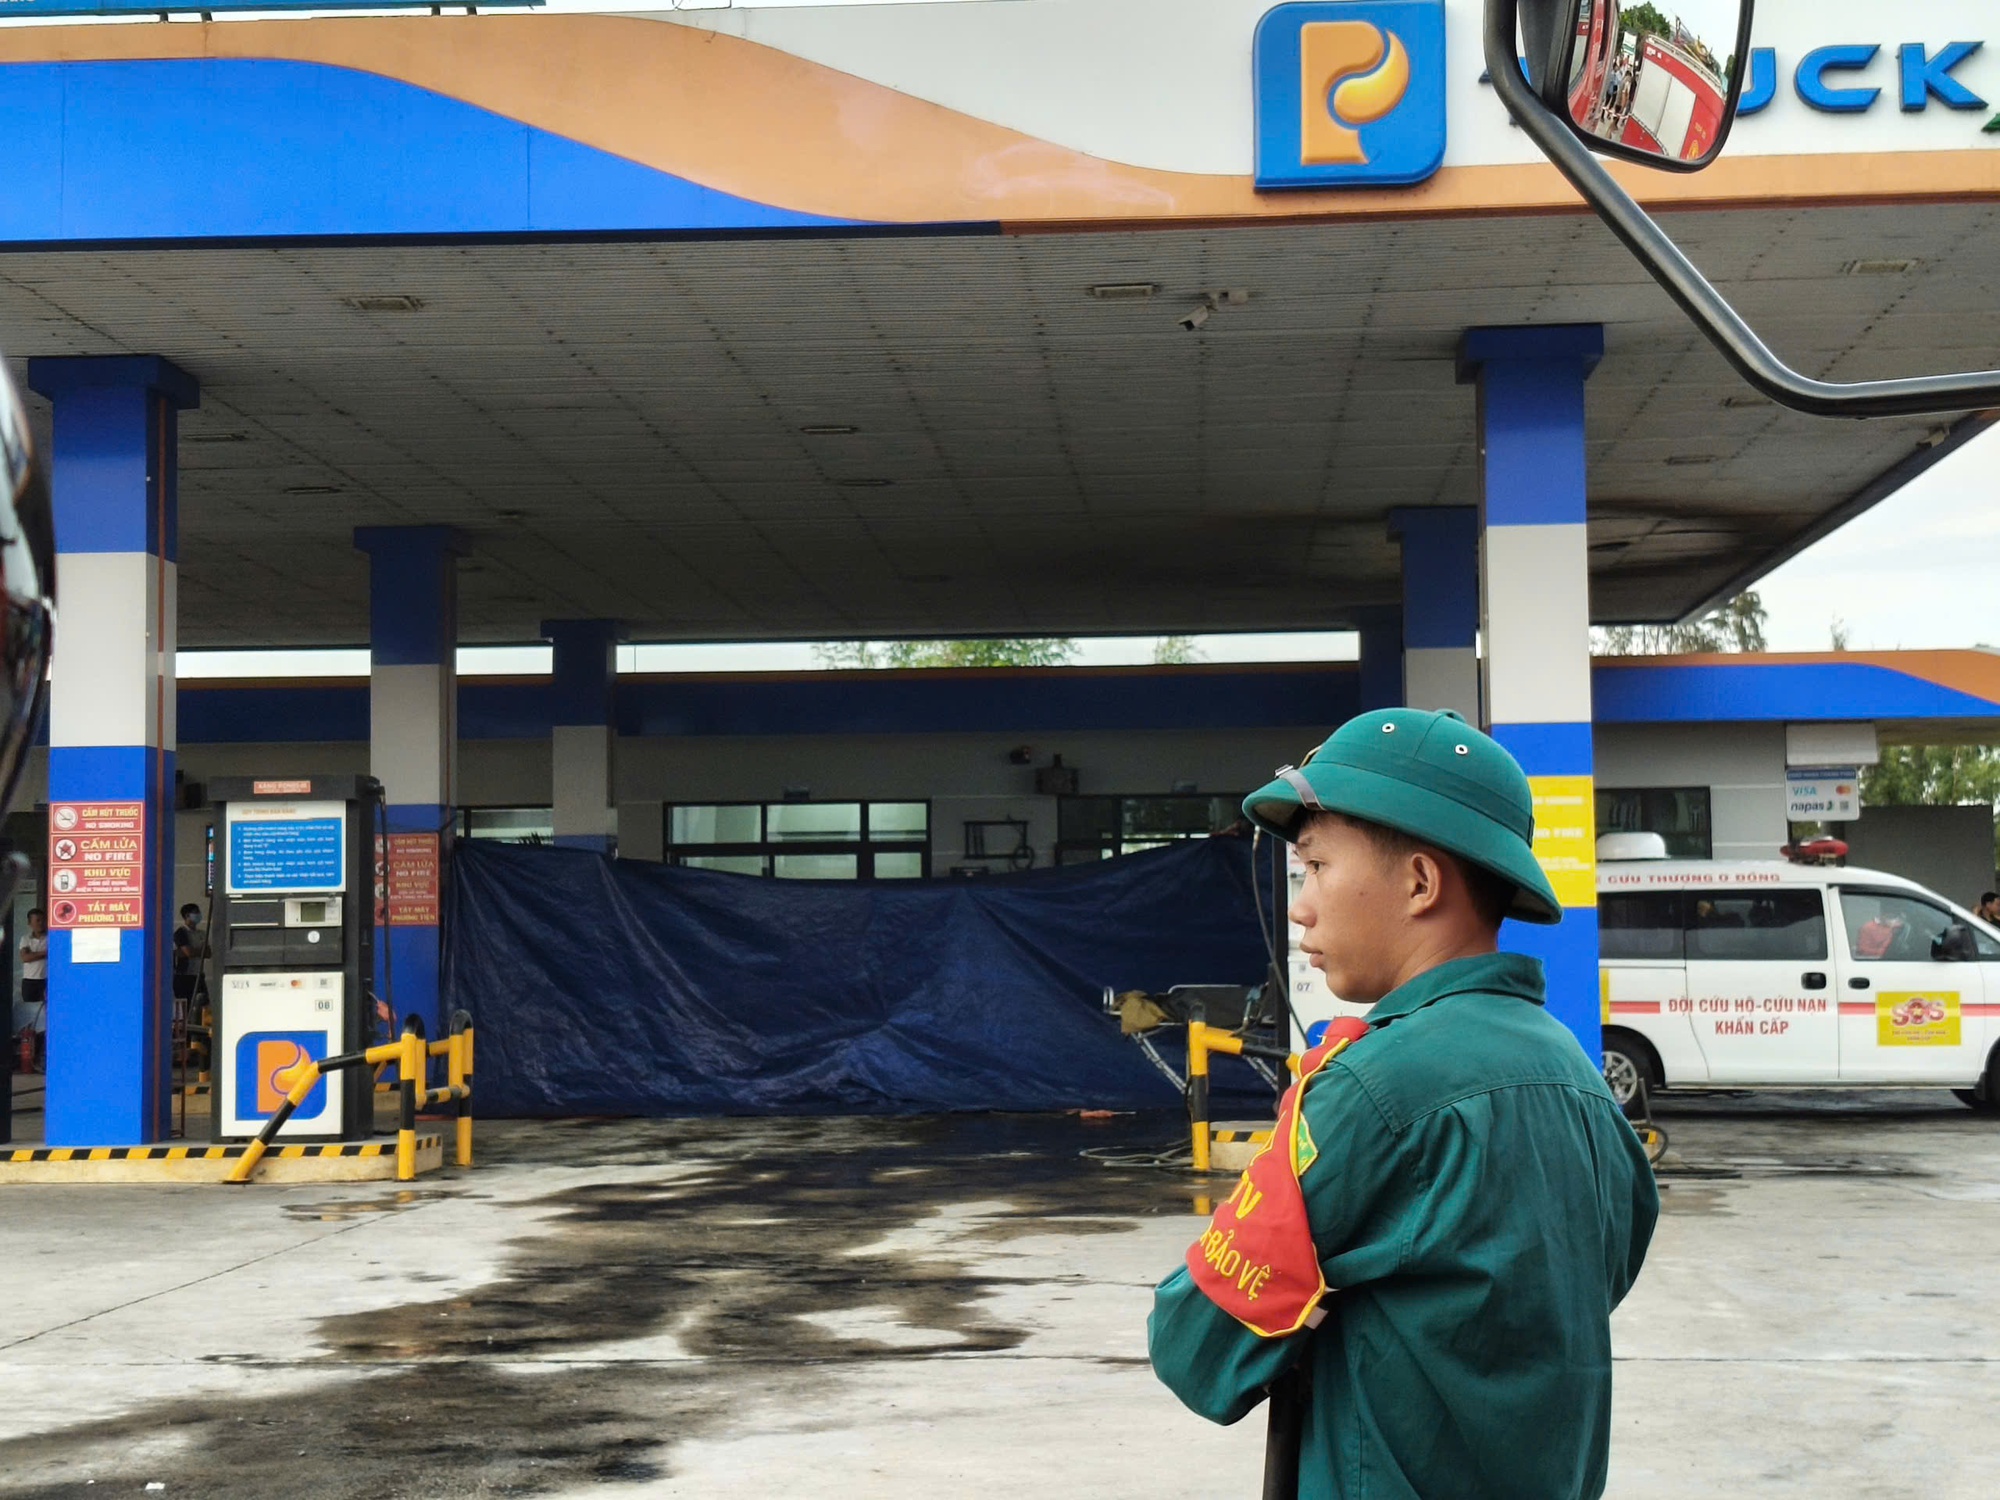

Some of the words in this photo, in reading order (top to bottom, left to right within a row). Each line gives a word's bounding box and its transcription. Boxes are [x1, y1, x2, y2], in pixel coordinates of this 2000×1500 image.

[1793, 786, 1817, 796] VISA
[1790, 801, 1824, 813] napas
[80, 837, 110, 849] CẤM
[114, 836, 137, 849] LỬA
[84, 852, 102, 861] NO
[105, 852, 134, 861] FIRE
[84, 868, 107, 877] KHU
[109, 901, 131, 912] MÁY
[1297, 982, 1311, 992] 07
[318, 1001, 330, 1010] 08
[1668, 996, 1694, 1016] ĐỘI
[1698, 995, 1729, 1013] CỨU
[1797, 998, 1828, 1016] NẠN
[1891, 997, 1945, 1027] SOS
[1759, 1016, 1790, 1035] CẤP
[1205, 1229, 1242, 1278] BẢO
[1237, 1259, 1271, 1301] VỆ
